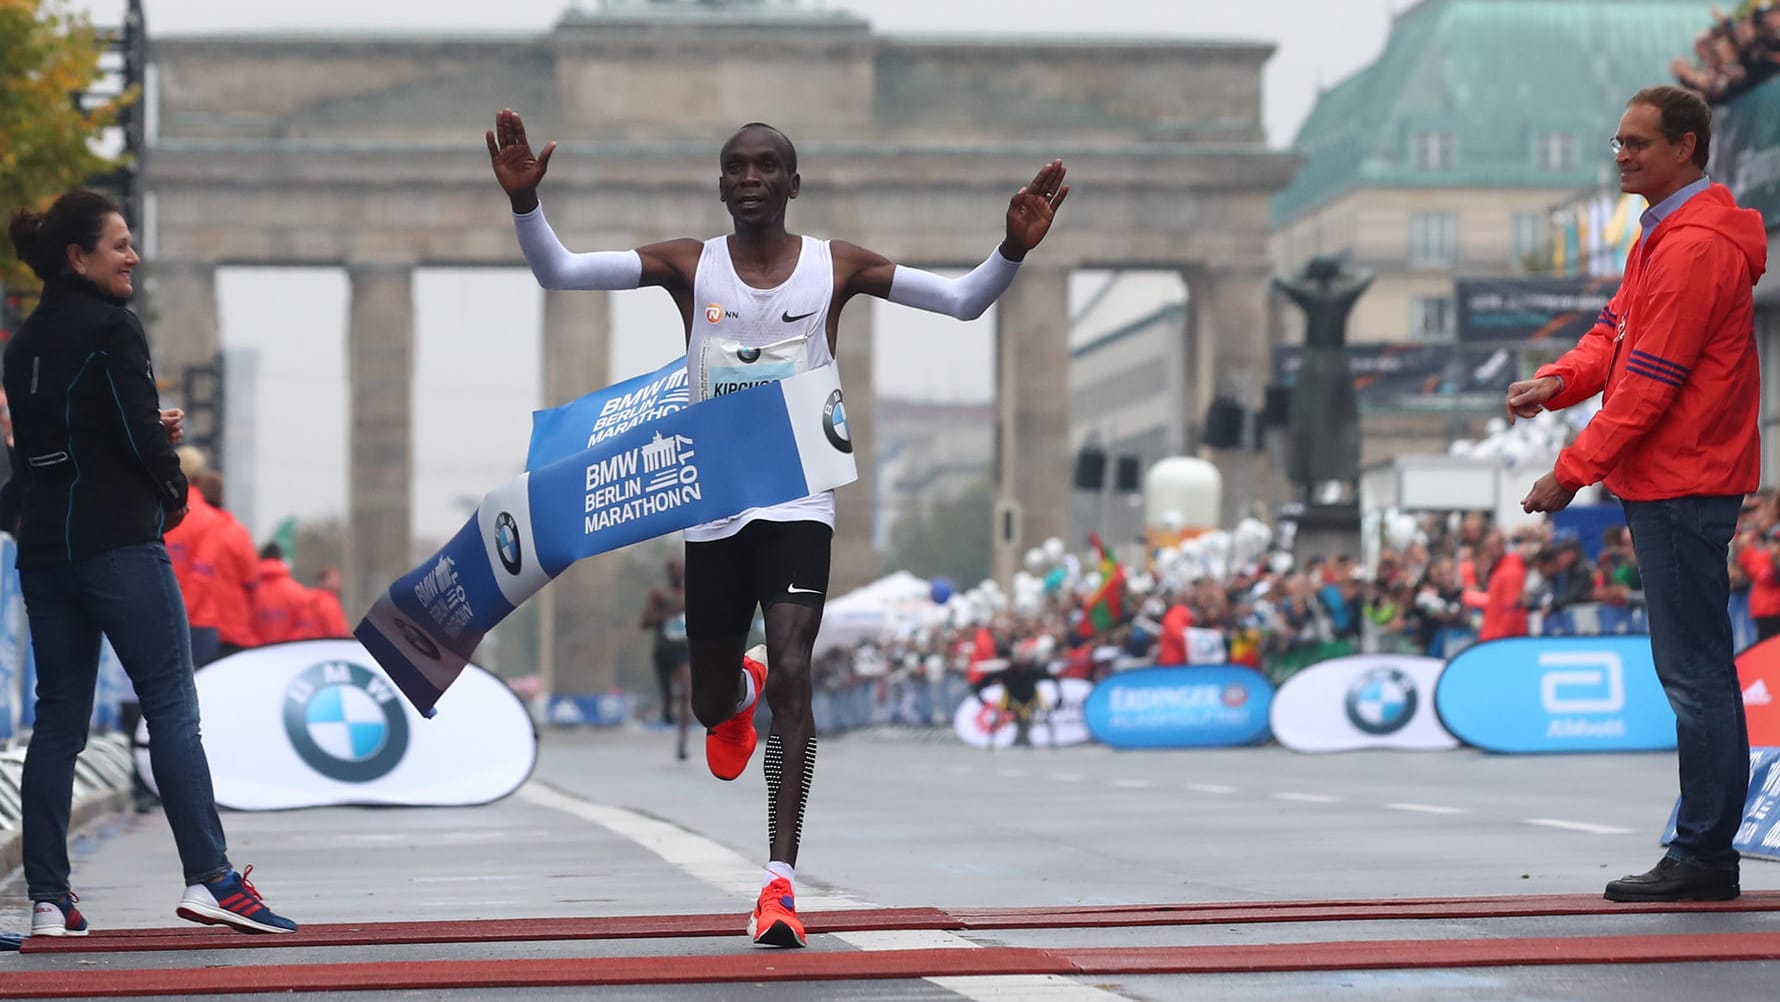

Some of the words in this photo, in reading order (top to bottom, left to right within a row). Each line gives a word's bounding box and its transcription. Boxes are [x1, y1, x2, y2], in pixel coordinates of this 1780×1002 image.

[725, 311, 739, 319] NN
[592, 395, 659, 433] BERLIN
[600, 377, 667, 417] BMW
[586, 404, 688, 449] MARATHO
[585, 448, 639, 491] BMW
[674, 434, 702, 504] 2017
[584, 488, 681, 535] MARATHON
[585, 477, 642, 513] BERLIN
